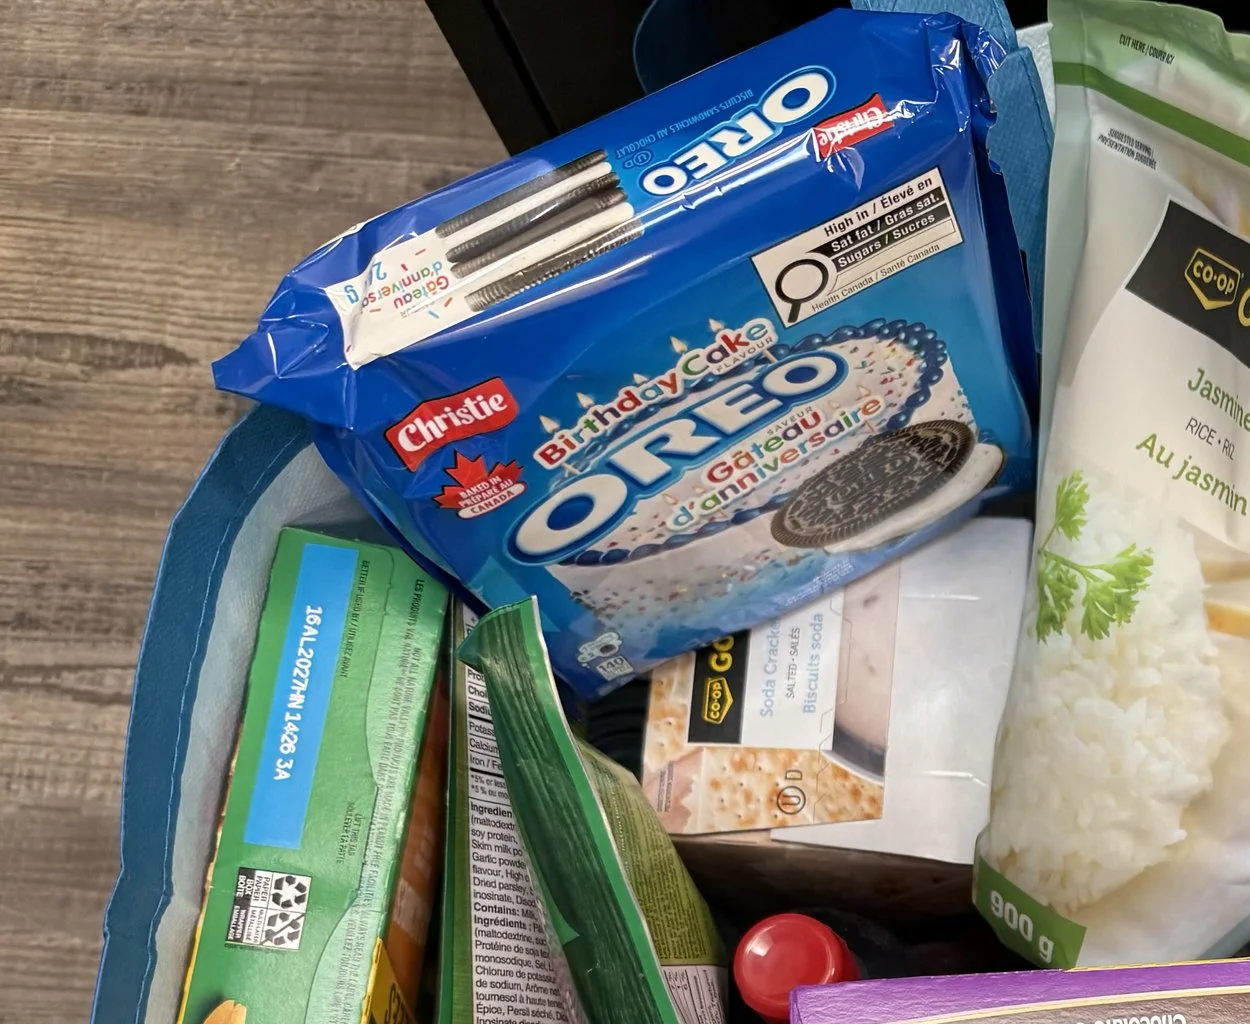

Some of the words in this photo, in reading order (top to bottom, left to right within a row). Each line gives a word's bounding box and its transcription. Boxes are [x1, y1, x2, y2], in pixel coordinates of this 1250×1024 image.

[638, 64, 834, 202] OREO
[823, 215, 854, 237] High
[855, 207, 869, 221] in
[879, 184, 914, 209] Élevé
[916, 176, 933, 190] en
[830, 233, 853, 252] Sat
[855, 223, 874, 240] fat
[883, 204, 914, 226] Gras
[915, 191, 940, 210] sat.
[837, 240, 882, 268] Sugars
[891, 212, 936, 240] Sucres
[811, 292, 840, 312] Health
[840, 275, 874, 298] Canada
[879, 257, 905, 277] Santé
[905, 242, 940, 264] Canada
[715, 335, 775, 374] FLAVOUR
[537, 366, 684, 469] Birthday
[678, 314, 771, 380] Cake
[394, 380, 510, 458] Christie
[1184, 416, 1217, 446] RICE
[1220, 438, 1238, 461] RIZ
[514, 353, 835, 554] OREO
[669, 394, 884, 530] d'anniversaire
[704, 407, 824, 487] Gâteau
[1135, 431, 1176, 469] Au
[457, 482, 499, 509] PRÉPARÉ
[498, 476, 514, 490] AU
[459, 480, 487, 501] BAKED
[486, 474, 501, 487] IN
[469, 488, 515, 516] CANADA
[763, 619, 781, 675] Cracke
[789, 626, 800, 656] SALÉS
[810, 611, 824, 650] soda
[759, 677, 776, 718] Soda
[784, 662, 797, 699] SALTED
[802, 652, 821, 714] Biscuits
[272, 757, 293, 781] 3A
[252, 875, 262, 901] PAPIER
[259, 876, 270, 902] PAPER
[987, 889, 1036, 942] 900
[1038, 935, 1055, 963] g
